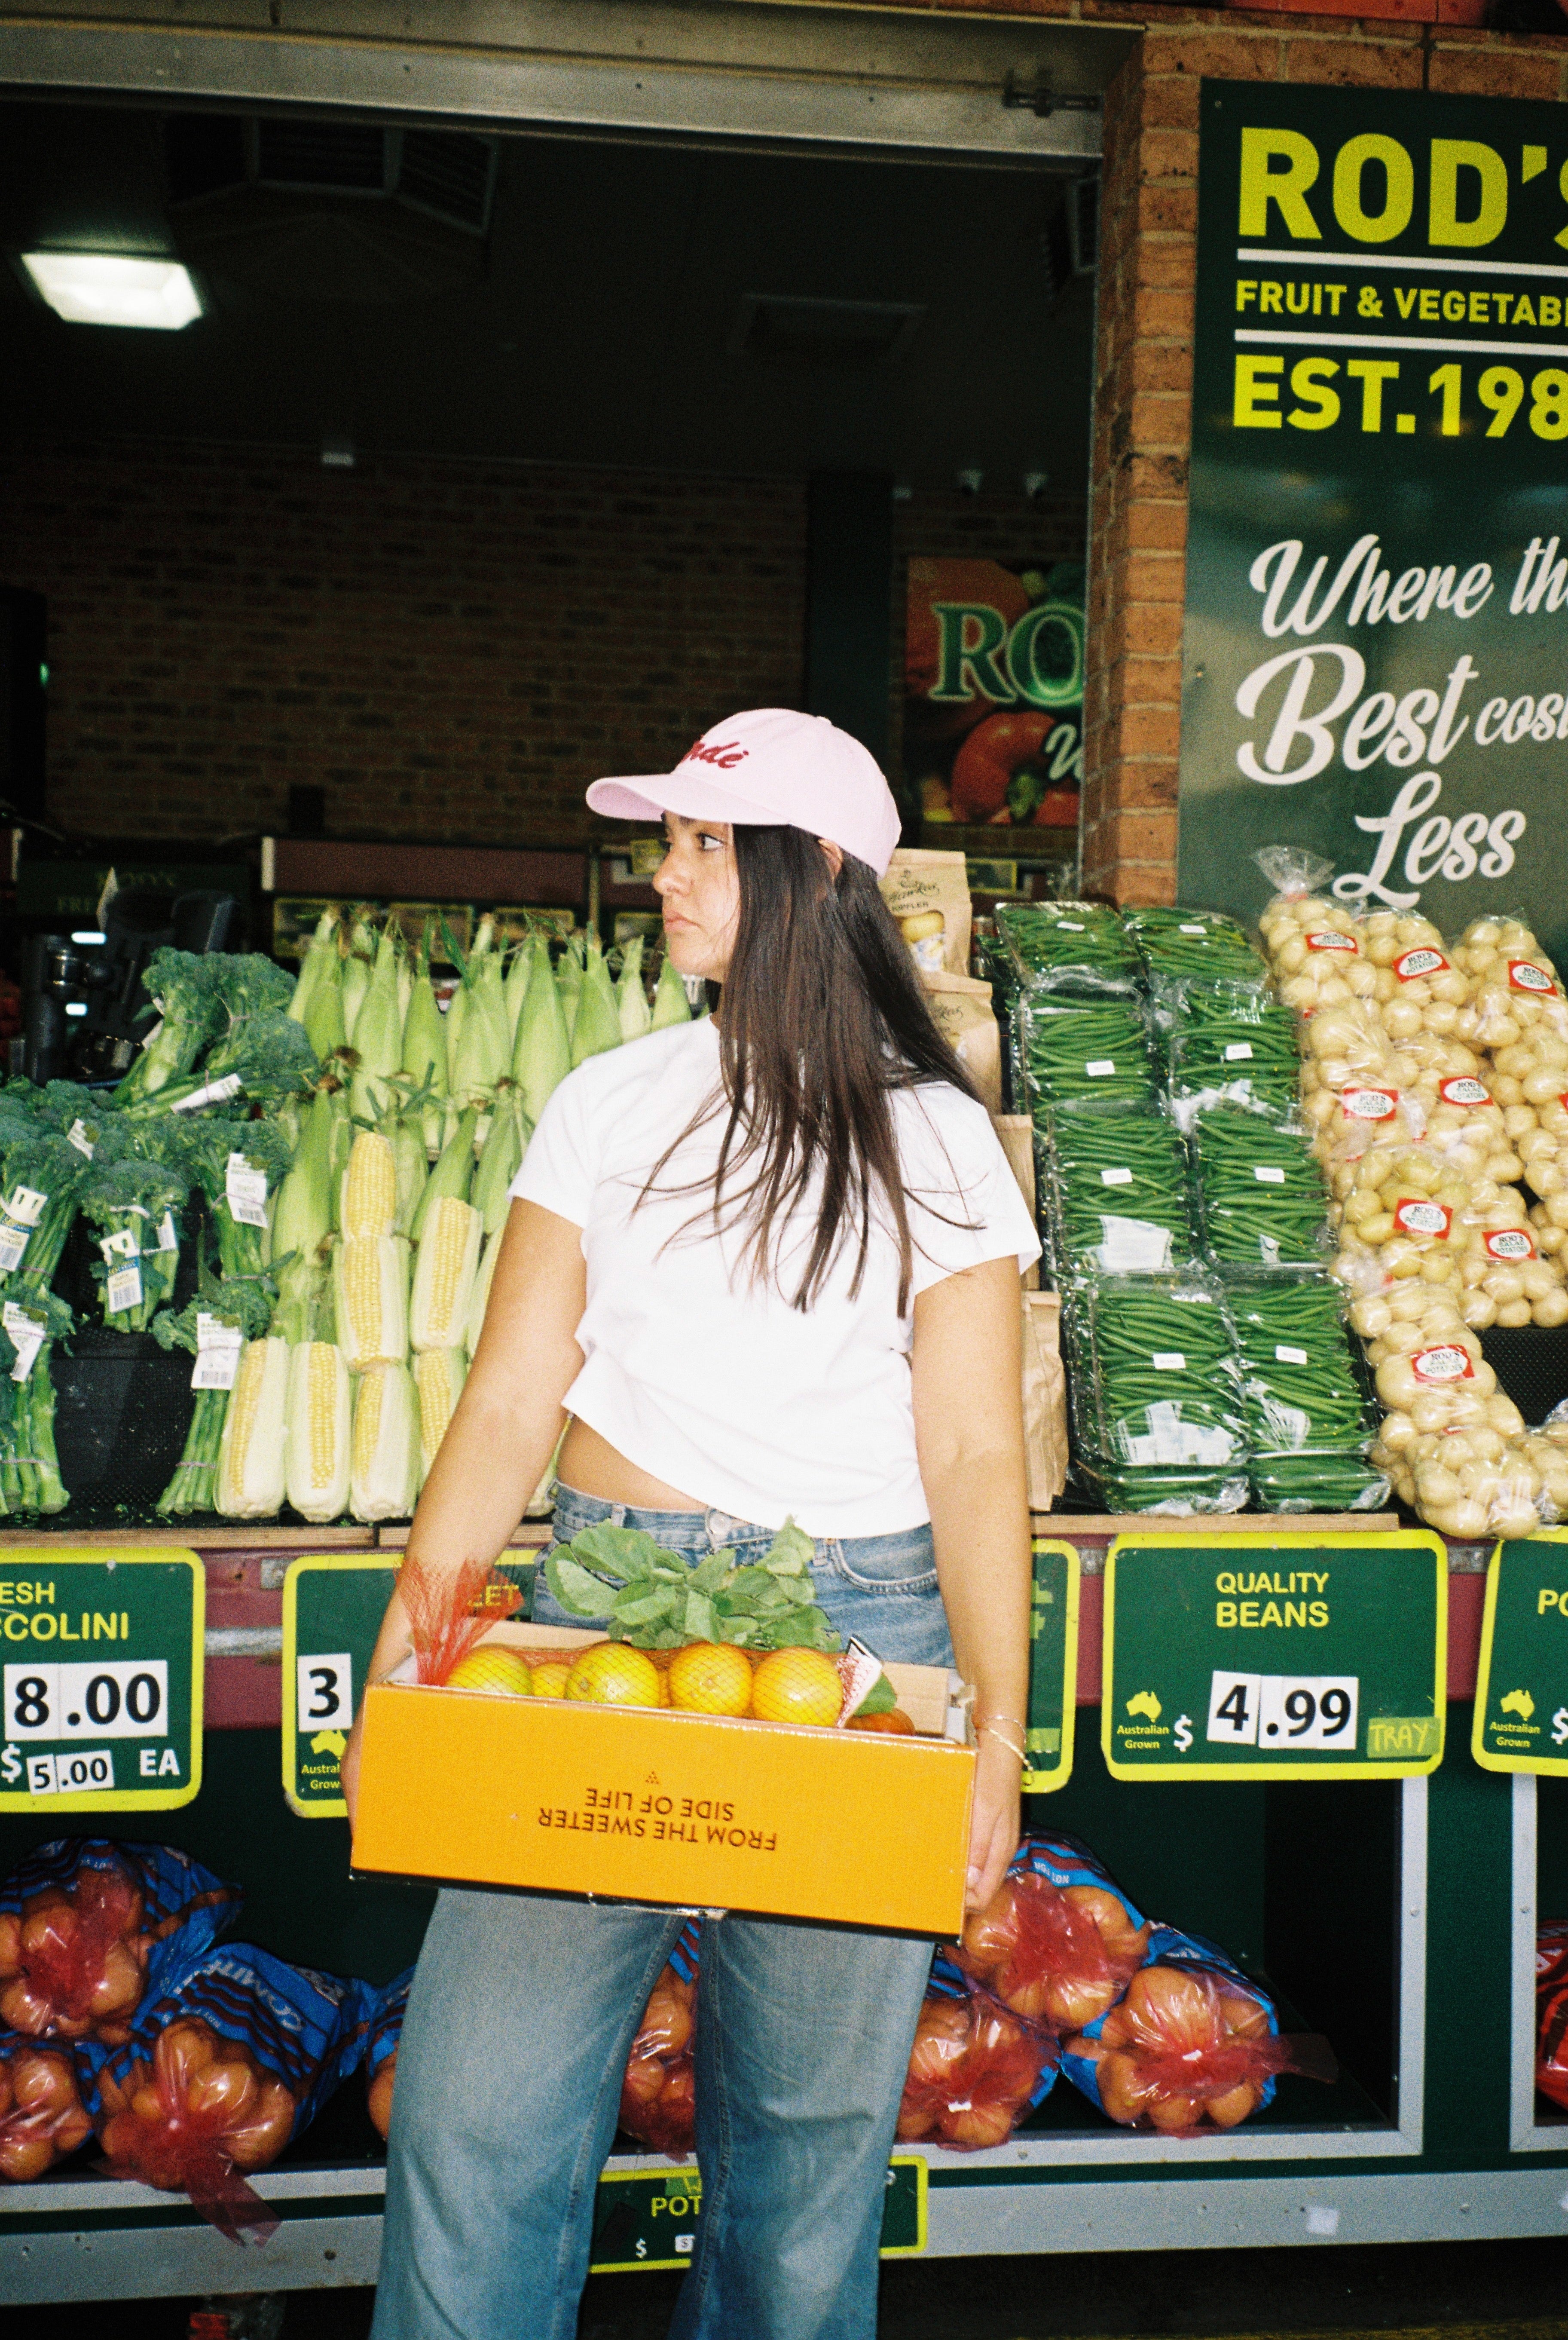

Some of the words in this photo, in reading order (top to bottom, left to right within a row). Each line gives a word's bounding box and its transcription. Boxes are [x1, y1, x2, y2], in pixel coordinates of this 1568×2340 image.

[1239, 127, 1568, 250] ROD'
[1236, 280, 1347, 317] FRUIT
[1357, 285, 1384, 319] &
[1394, 288, 1568, 328] VEGETAB
[1249, 534, 1495, 637] Where
[1510, 536, 1568, 615] th
[1235, 643, 1479, 785] Best
[1332, 772, 1526, 908] Less
[1216, 1573, 1329, 1594] QUALITY
[0, 1612, 128, 1641] COLINI
[1216, 1602, 1329, 1628] BEANS
[14, 1673, 160, 1727] 8.00
[308, 1668, 339, 1718] 3
[1117, 1724, 1169, 1736] Australian
[1174, 1714, 1193, 1752] $
[1216, 1685, 1351, 1738] 4.99
[1369, 1724, 1430, 1752] TRAY
[1489, 1721, 1540, 1734] Australian
[1125, 1739, 1160, 1750] Grown
[1496, 1737, 1530, 1748] Grown
[1, 1744, 22, 1783] $
[33, 1757, 108, 1789] 5.00
[140, 1749, 180, 1776] EA
[585, 1787, 633, 1811] LIFE
[640, 1795, 673, 1815] OF
[682, 1798, 734, 1821] SIDE
[538, 1807, 645, 1837] SWEETER
[654, 1820, 698, 1843] THE
[707, 1825, 777, 1851] FROM
[636, 2238, 647, 2259] $
